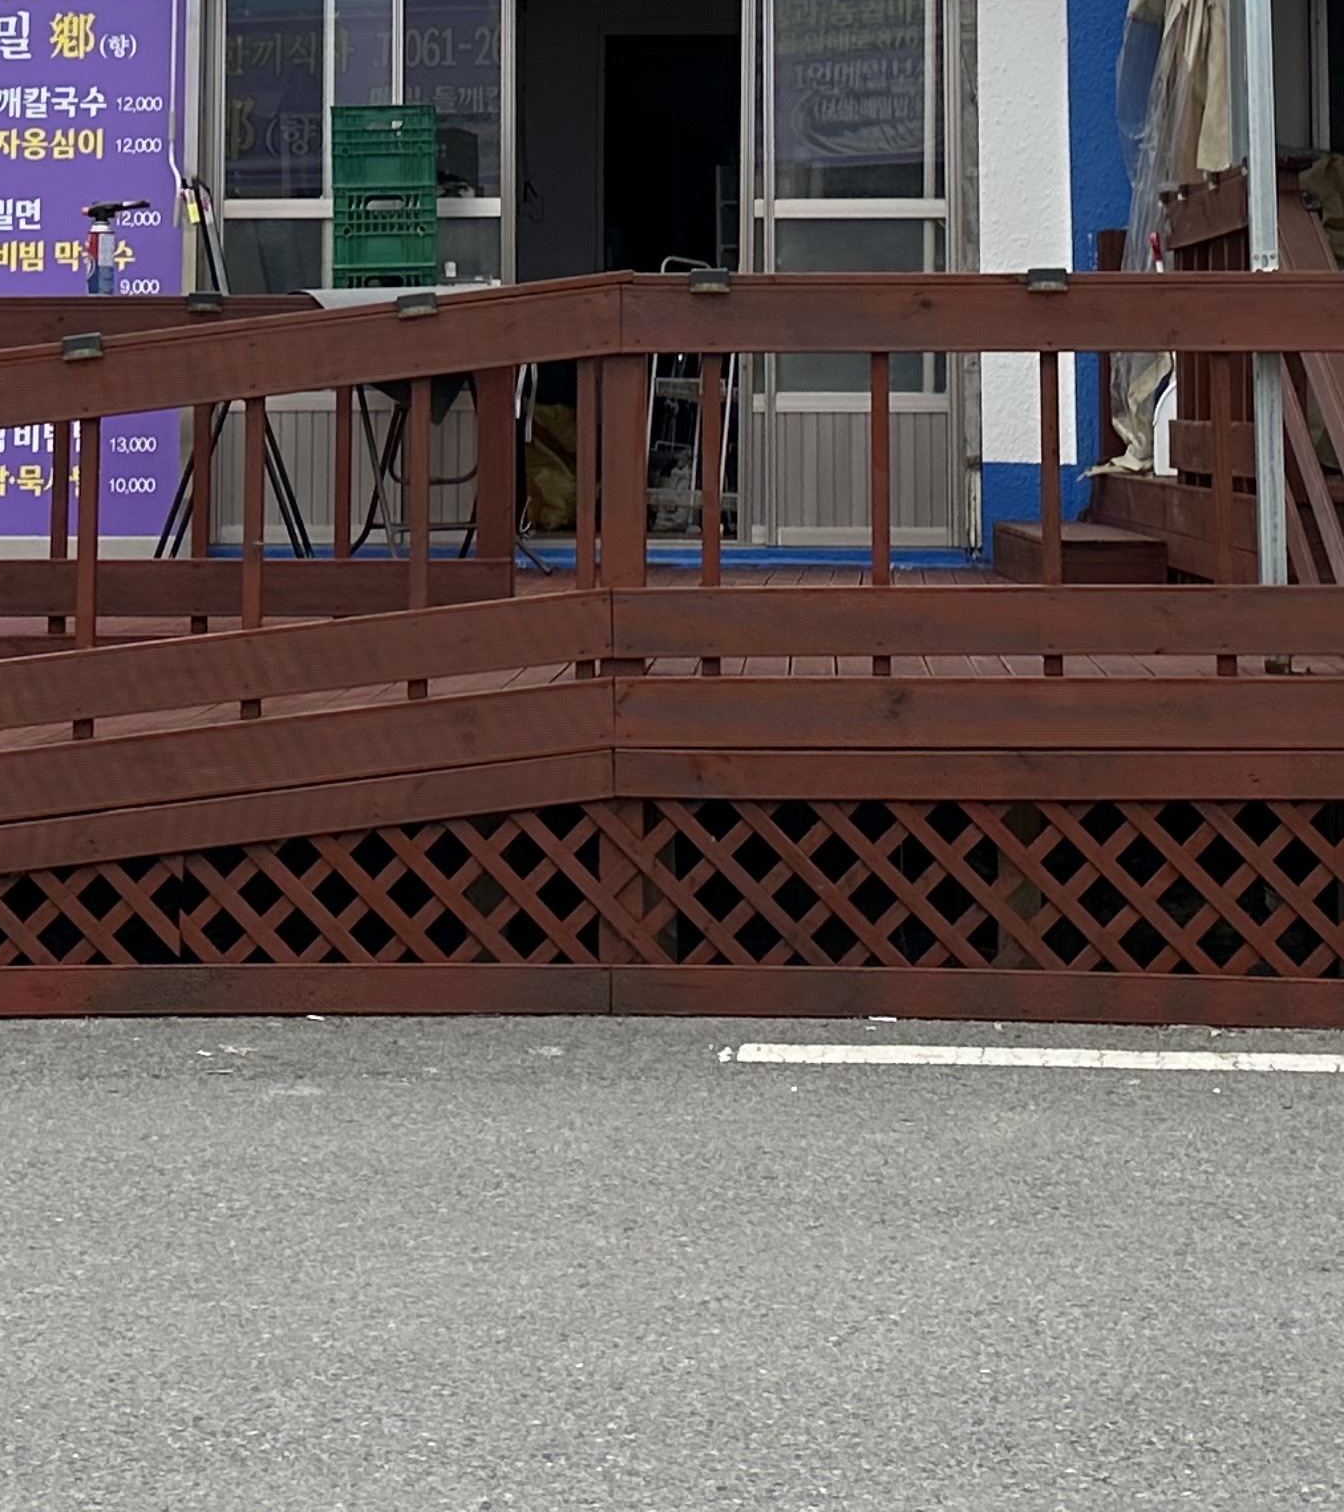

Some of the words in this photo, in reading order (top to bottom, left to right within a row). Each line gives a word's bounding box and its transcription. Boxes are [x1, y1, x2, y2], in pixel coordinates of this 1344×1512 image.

[116, 97, 163, 112] 12,000
[115, 139, 162, 153] 12,000
[55, 240, 135, 273] 막수
[120, 279, 160, 295] 9,000
[109, 438, 157, 453] 13,000
[109, 477, 157, 494] 10,000
